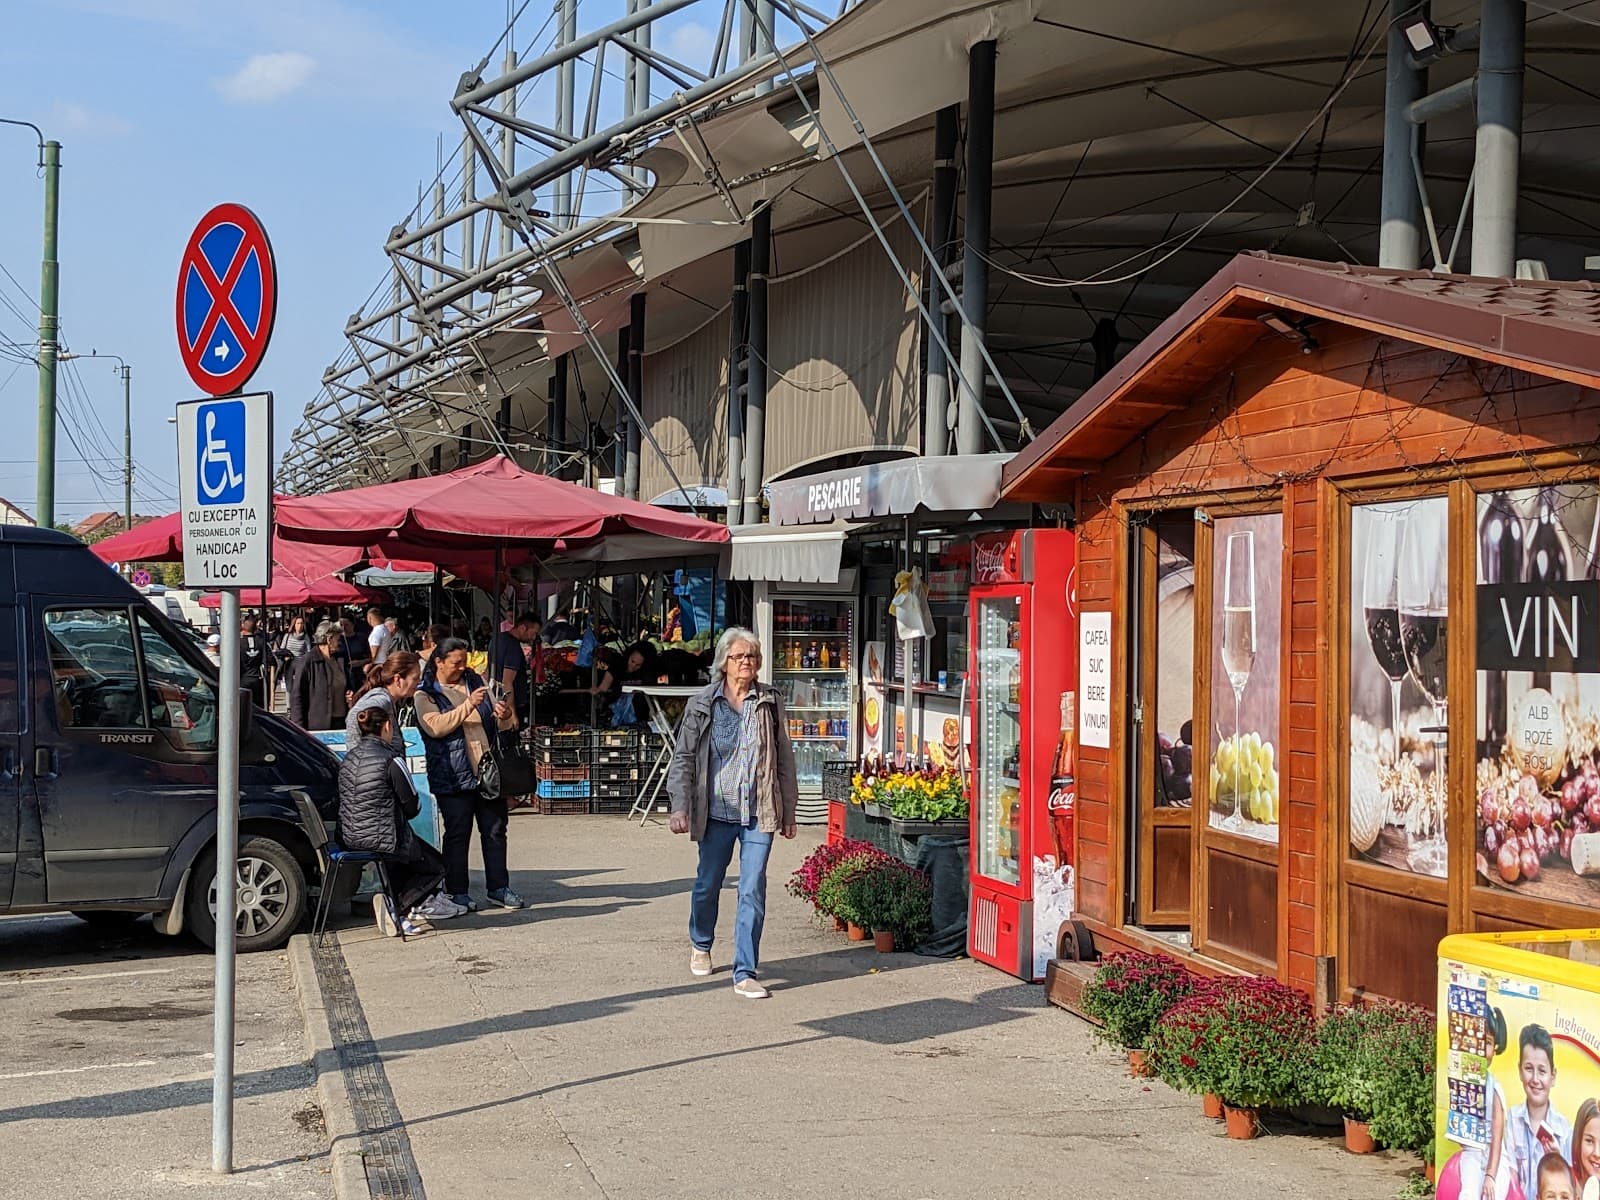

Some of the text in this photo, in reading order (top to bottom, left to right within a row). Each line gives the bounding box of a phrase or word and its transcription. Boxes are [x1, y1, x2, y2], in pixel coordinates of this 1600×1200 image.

[808, 476, 862, 512] PESCARIE
[188, 508, 256, 526] CU EXCEPȚIA
[189, 527, 257, 538] PERSOANELOR CU
[196, 542, 247, 556] HANDICAP
[203, 560, 209, 578] 1
[1499, 595, 1579, 658] VIN
[1085, 630, 1108, 646] CAFEA
[1089, 658, 1104, 673] SUC
[1087, 685, 1105, 701] BERE
[1084, 712, 1108, 729] VINURI
[1527, 705, 1549, 720] ALB
[99, 734, 155, 743] TRANSIT
